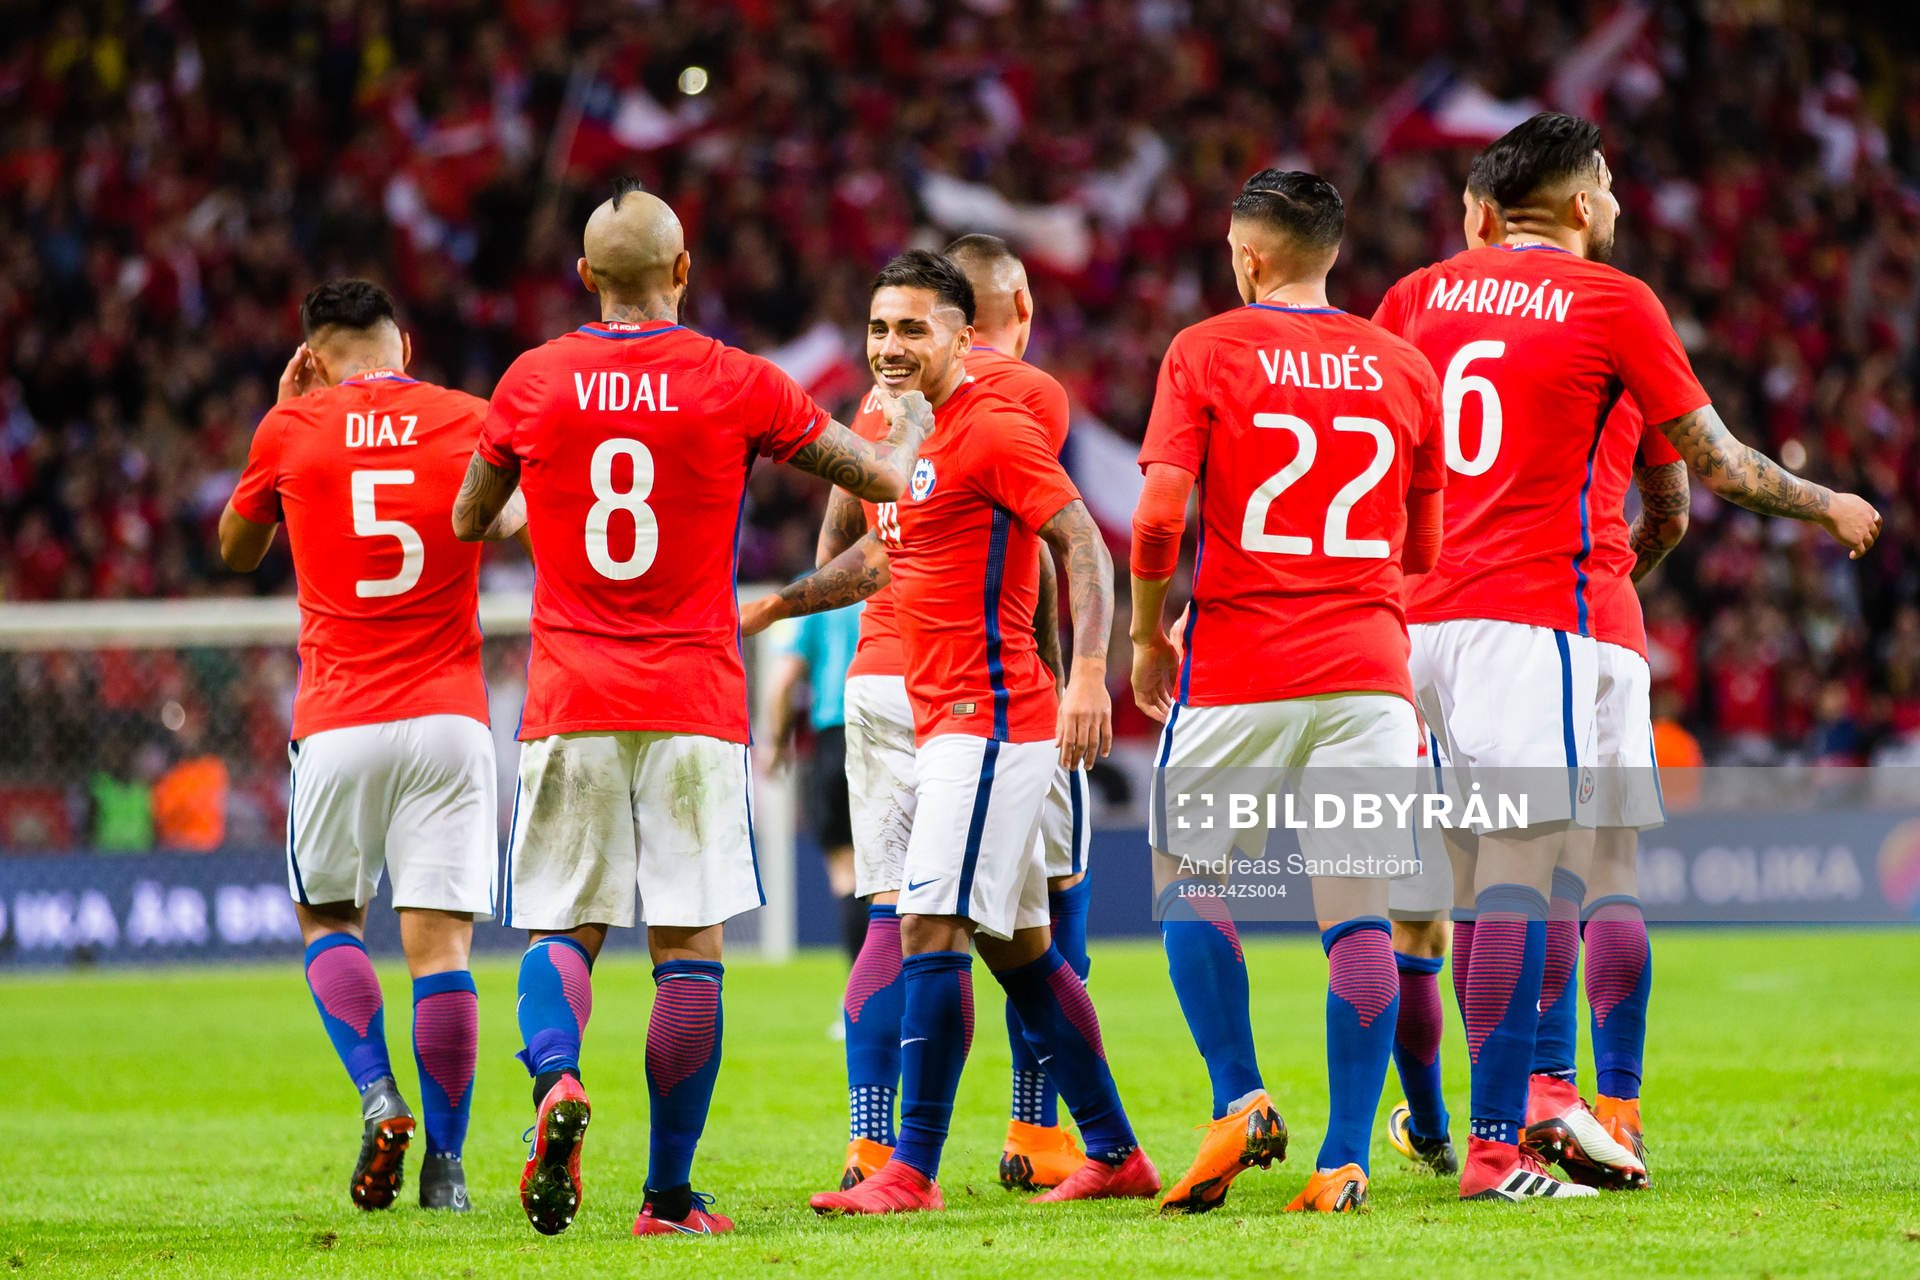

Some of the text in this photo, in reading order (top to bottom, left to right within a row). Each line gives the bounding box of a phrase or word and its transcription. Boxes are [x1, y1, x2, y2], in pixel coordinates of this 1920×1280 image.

[1427, 278, 1574, 323] MARIPÁN
[608, 322, 619, 331] LA
[364, 372, 374, 381] LA
[1257, 345, 1384, 392] VALDÉS
[574, 372, 679, 412] VIDAL
[1442, 340, 1506, 477] 6
[345, 410, 418, 448] DÍAZ
[1240, 412, 1396, 559] 22
[585, 437, 659, 581] 8
[351, 469, 425, 598] 5
